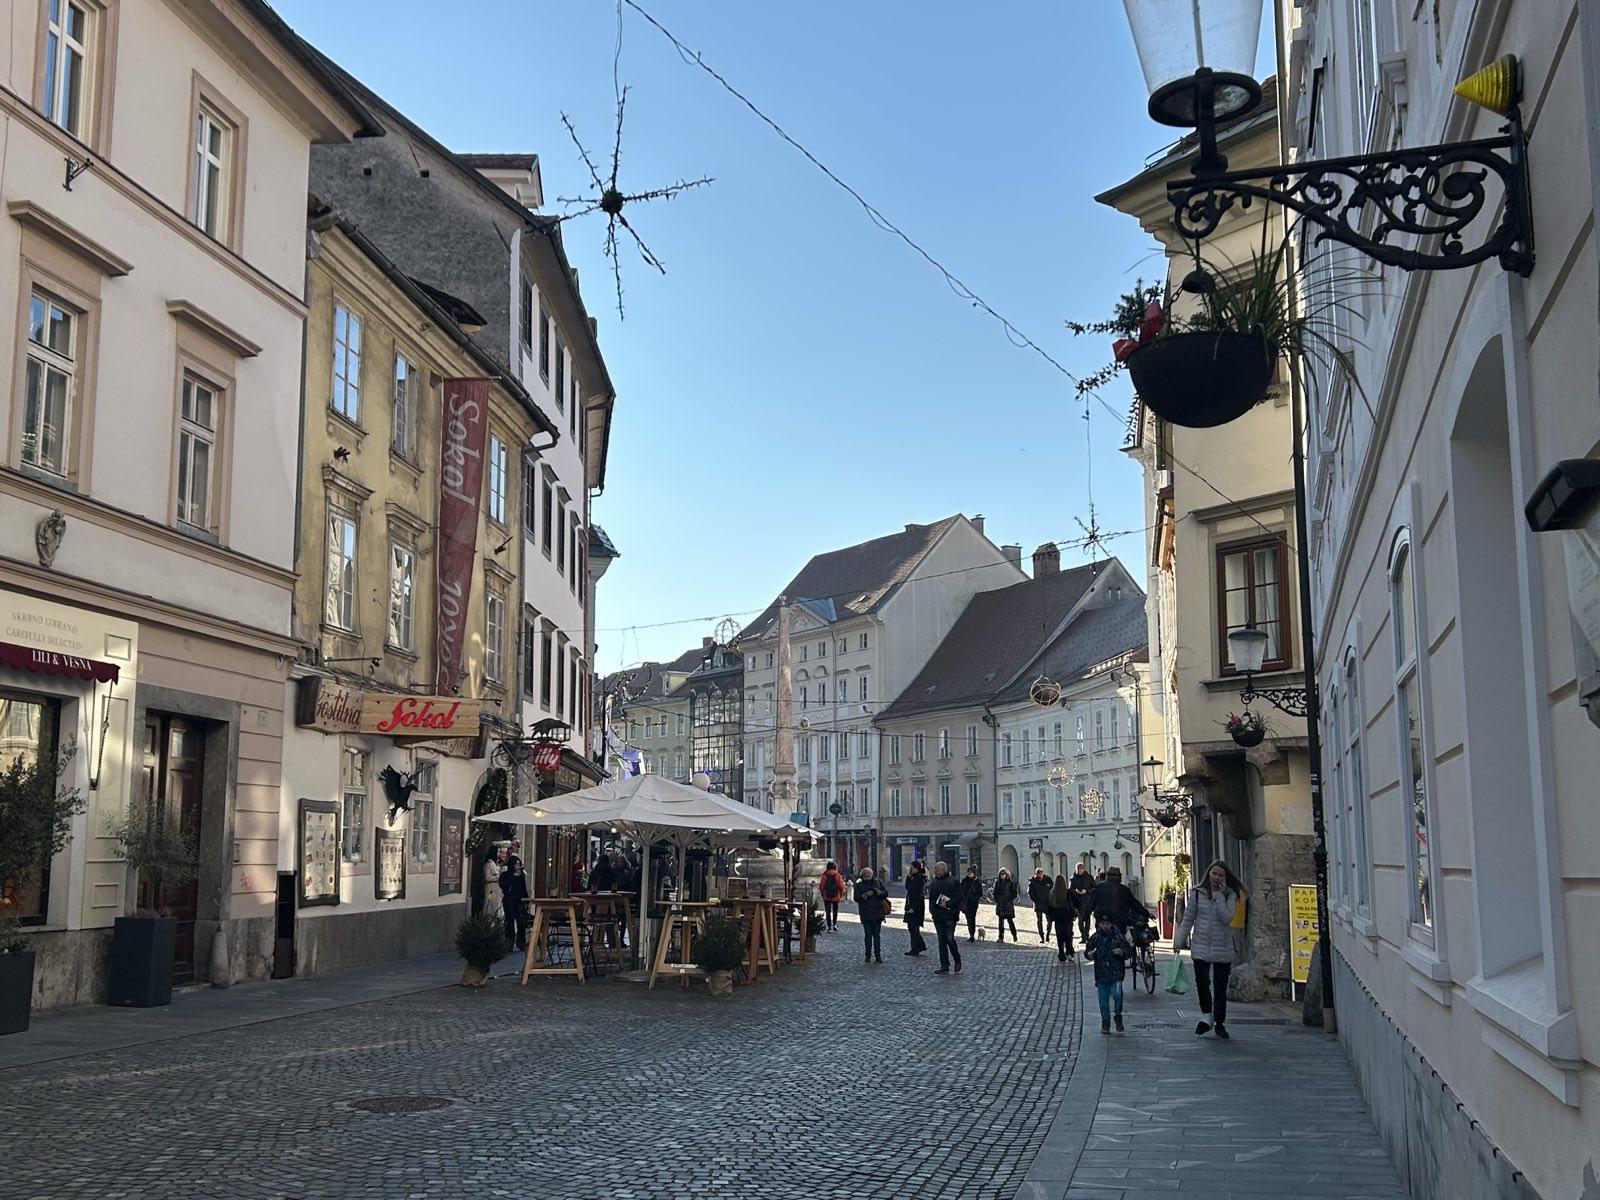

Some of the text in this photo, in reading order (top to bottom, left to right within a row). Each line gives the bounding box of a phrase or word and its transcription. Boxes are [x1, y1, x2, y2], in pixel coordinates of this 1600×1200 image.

[441, 392, 480, 506] Sokol
[12, 611, 78, 633] SKRBNO IZBRANO
[5, 627, 82, 650] CAREFULLY SELECTED
[32, 649, 92, 671] LILI & VESNA
[377, 697, 461, 732] Sokol
[534, 747, 559, 769] illy
